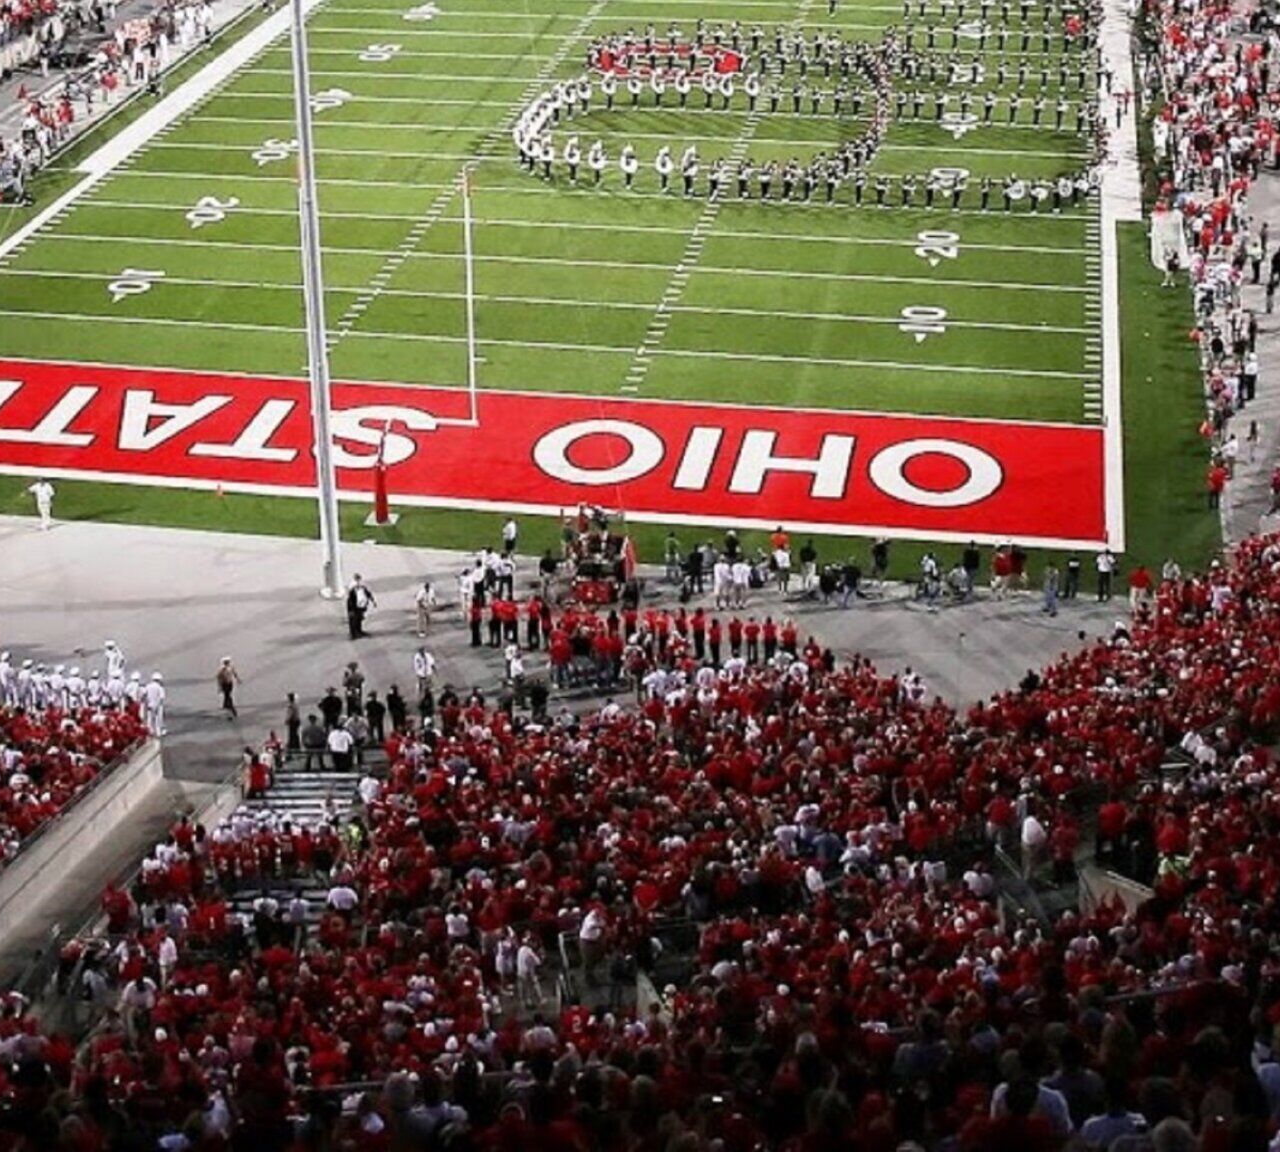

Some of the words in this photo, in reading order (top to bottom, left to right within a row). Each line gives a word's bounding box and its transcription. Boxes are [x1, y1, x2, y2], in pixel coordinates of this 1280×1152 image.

[359, 43, 403, 62] 50
[251, 137, 300, 162] 30
[184, 195, 241, 222] 20
[914, 229, 961, 259] 20
[107, 267, 166, 295] 10
[898, 305, 948, 334] 10
[531, 418, 1005, 509] OHIO
